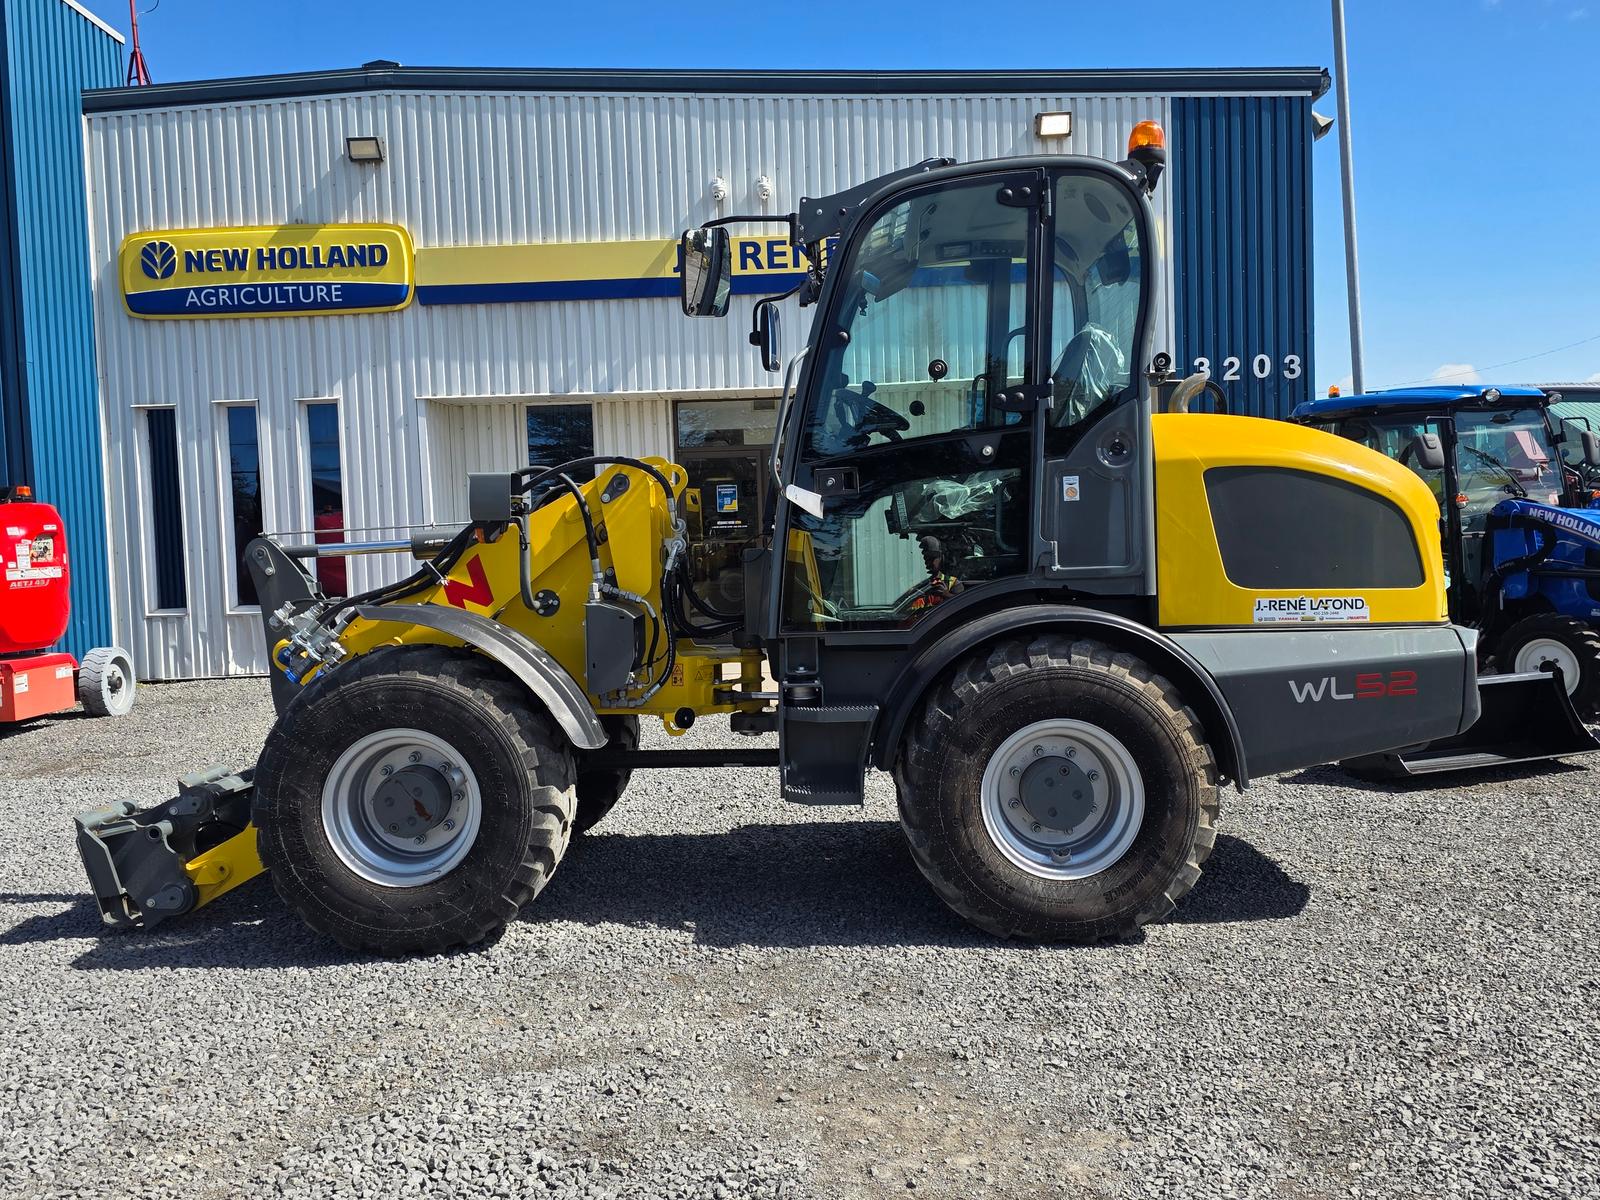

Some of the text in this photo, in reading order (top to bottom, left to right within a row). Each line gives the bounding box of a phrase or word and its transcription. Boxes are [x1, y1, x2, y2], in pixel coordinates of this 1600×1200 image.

[185, 244, 389, 273] NEW HOLLAND
[185, 284, 343, 307] AGRICULTURE
[1193, 353, 1302, 381] 3203
[1529, 507, 1600, 540] NEW HOLLAN
[1288, 670, 1418, 703] WL52
